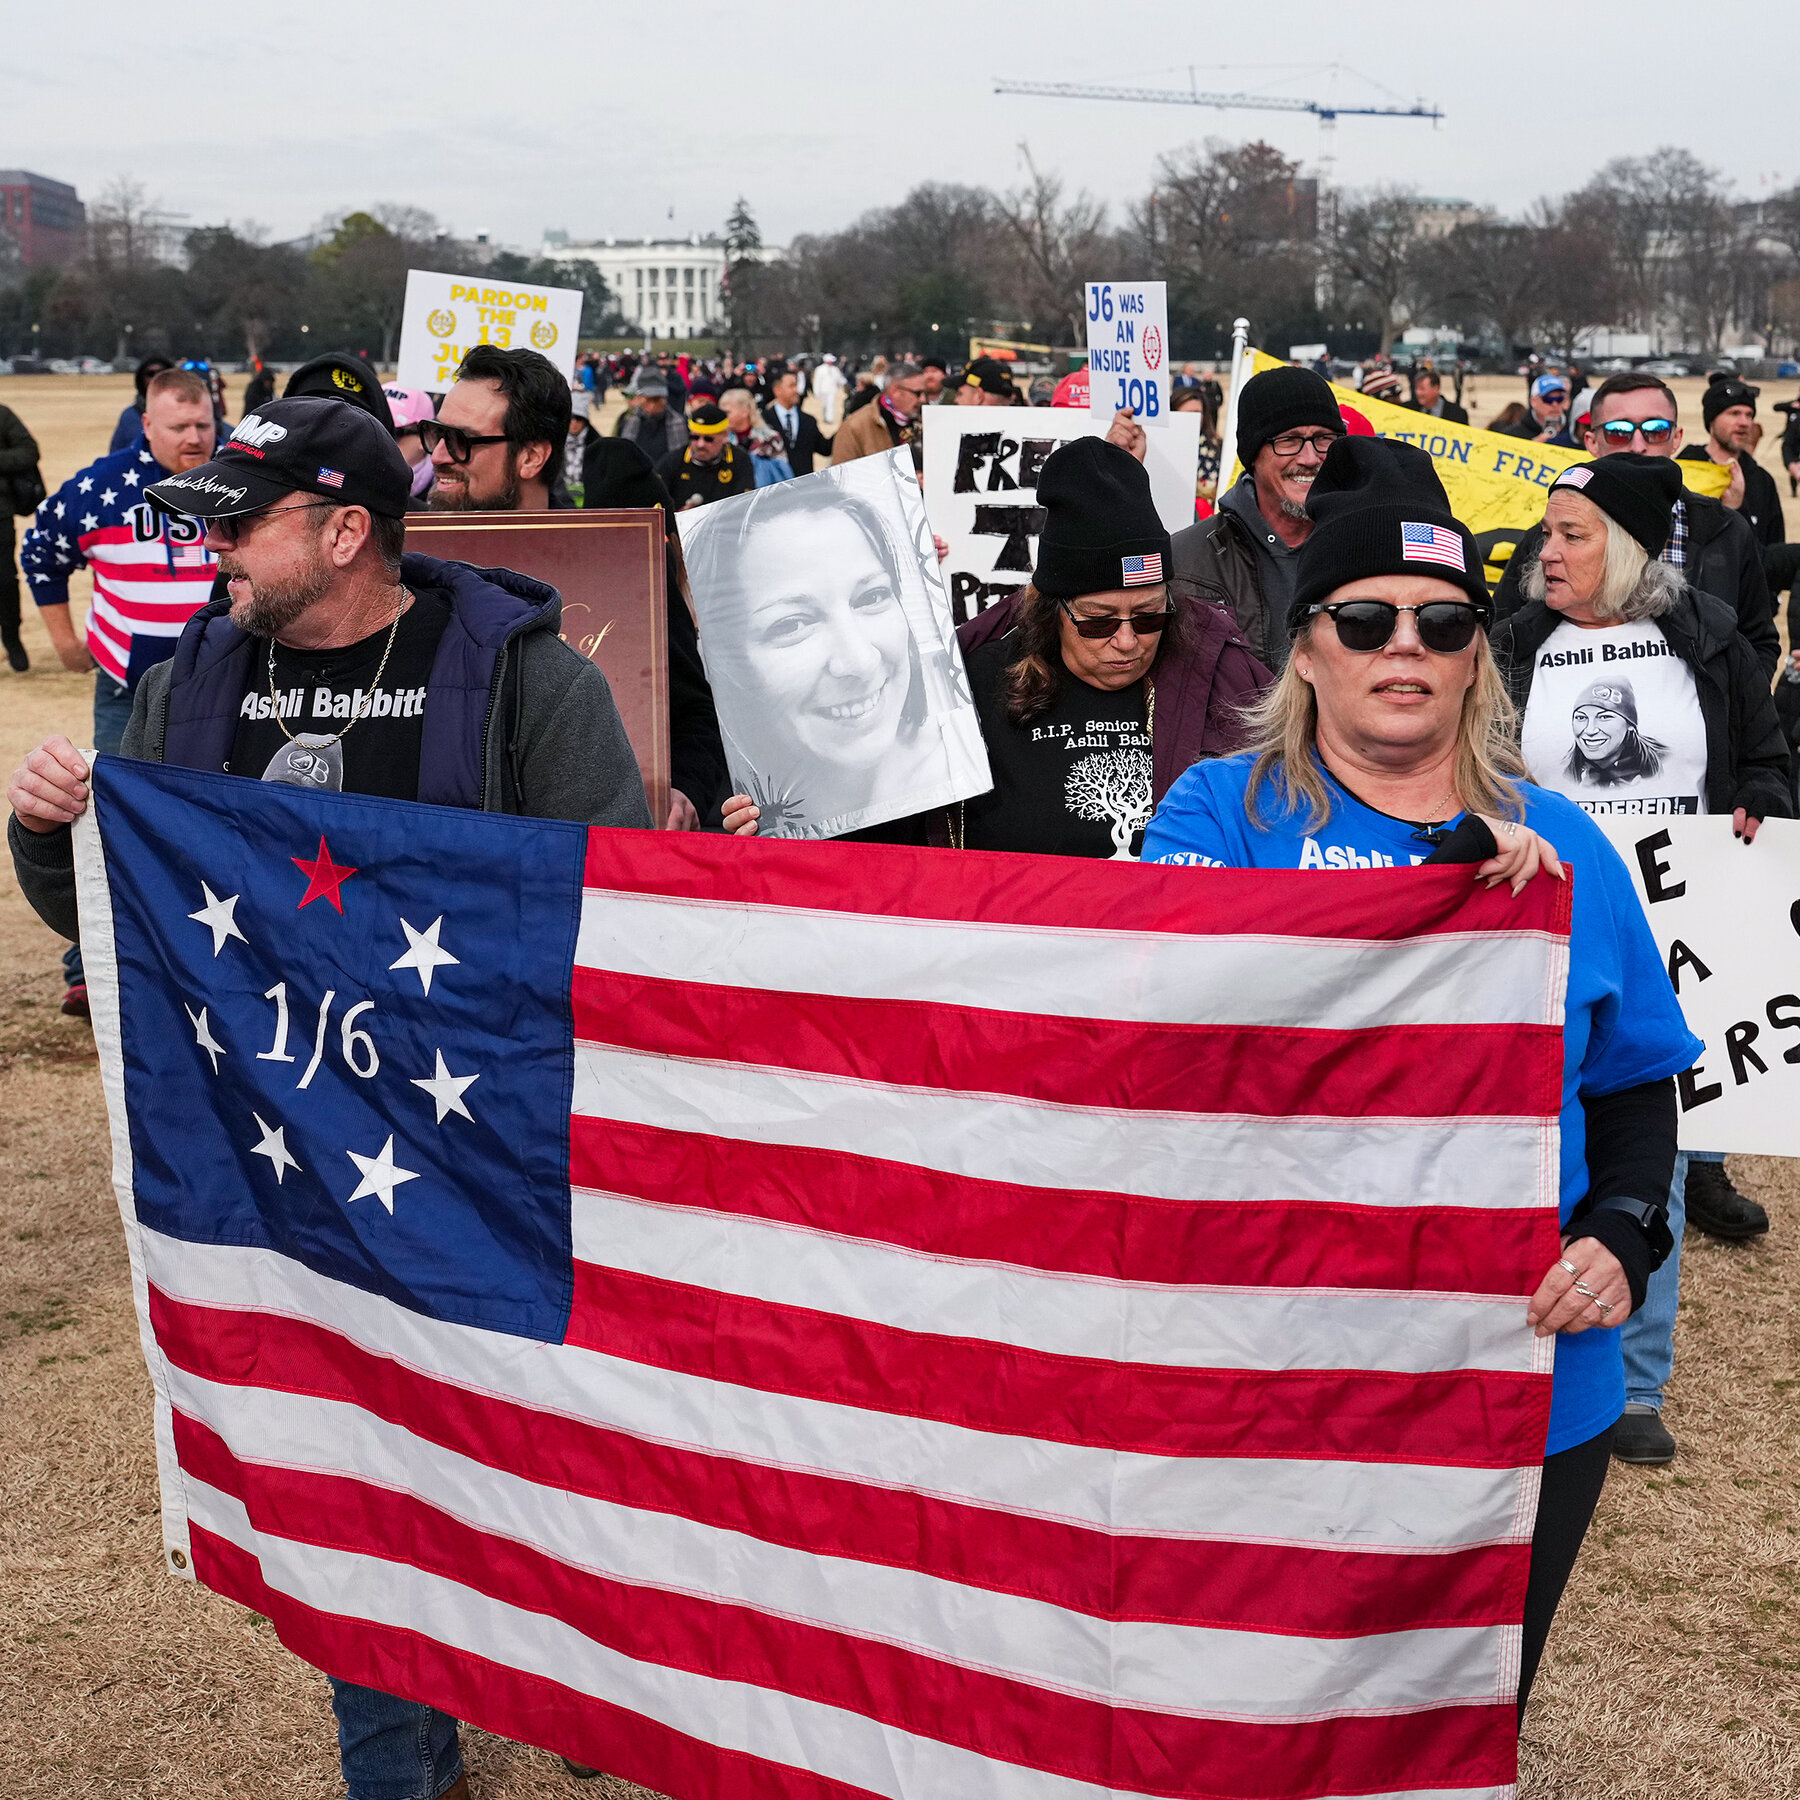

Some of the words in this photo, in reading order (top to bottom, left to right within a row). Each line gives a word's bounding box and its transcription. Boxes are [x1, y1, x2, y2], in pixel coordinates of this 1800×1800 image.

[451, 285, 547, 312] PARDON
[1089, 285, 1113, 322] J6
[1119, 294, 1144, 313] WAS
[477, 307, 516, 326] THE
[478, 325, 511, 348] 13
[1116, 320, 1134, 343] AN
[1091, 349, 1131, 373] INSIDE
[1115, 378, 1160, 417] JOB
[953, 430, 1073, 494] FRE
[1376, 432, 1473, 463] TION
[1493, 450, 1557, 488] FRE
[579, 619, 616, 659] of
[1540, 647, 1594, 668] Ashli
[240, 687, 305, 720] Ashli
[312, 686, 427, 719] Babbitt
[1031, 724, 1075, 742] R.I.P.
[1085, 720, 1139, 733] Senior
[1064, 734, 1109, 750] Ashli
[256, 982, 380, 1089] 1/6
